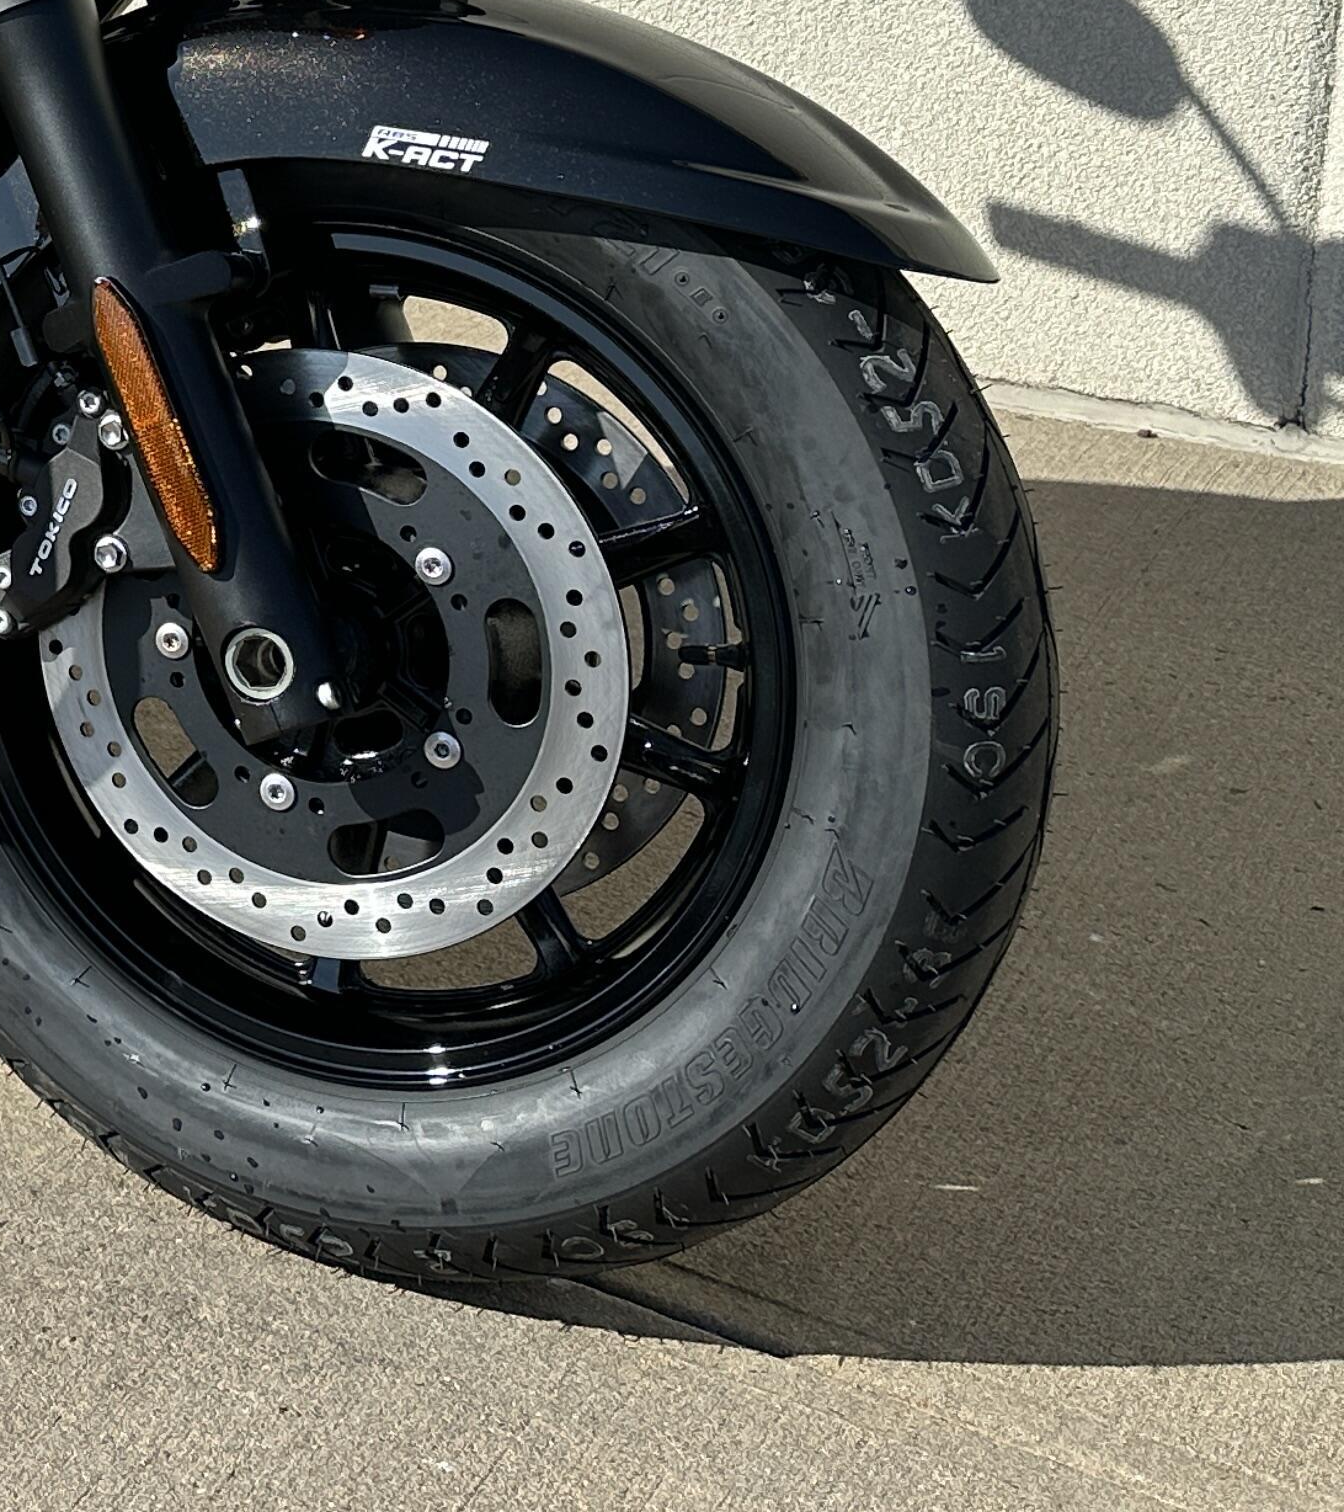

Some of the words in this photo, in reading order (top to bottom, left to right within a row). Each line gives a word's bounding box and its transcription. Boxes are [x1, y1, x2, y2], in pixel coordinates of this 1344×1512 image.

[362, 138, 484, 173] K-ACT
[29, 478, 78, 576] TOKICO
[548, 841, 874, 1179] BRIDGESTONE
